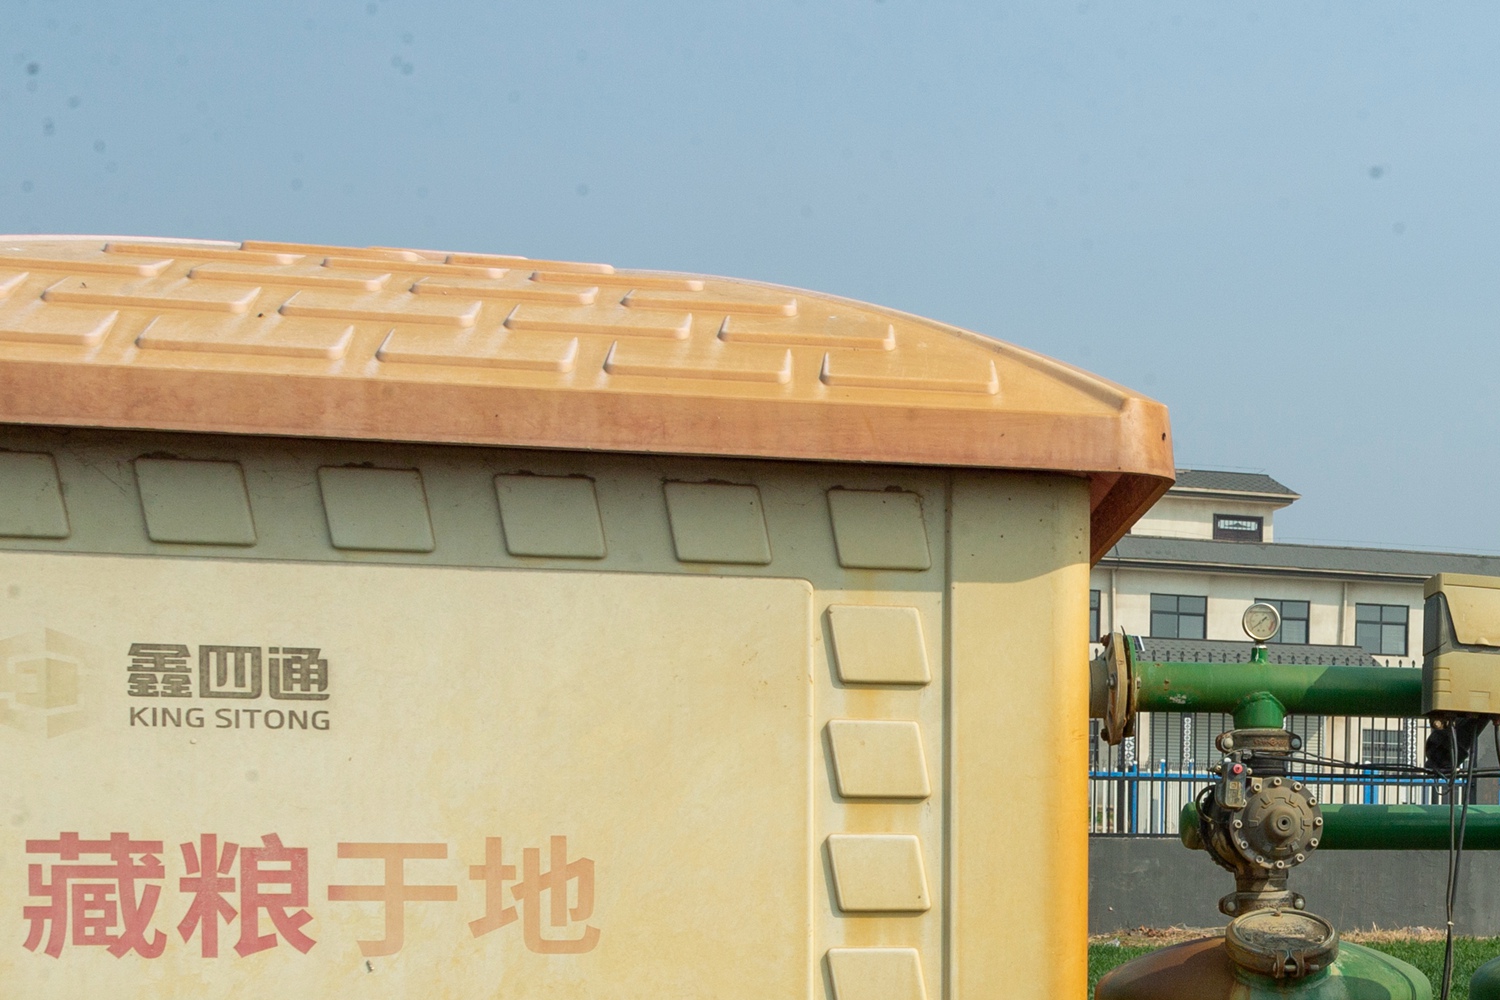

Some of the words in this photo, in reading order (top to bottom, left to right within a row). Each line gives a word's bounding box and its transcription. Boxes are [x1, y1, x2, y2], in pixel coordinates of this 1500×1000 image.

[127, 643, 330, 700] 鑫四通
[129, 706, 205, 728] KING
[214, 708, 330, 730] SITONG
[23, 832, 601, 960] 藏粮于地
